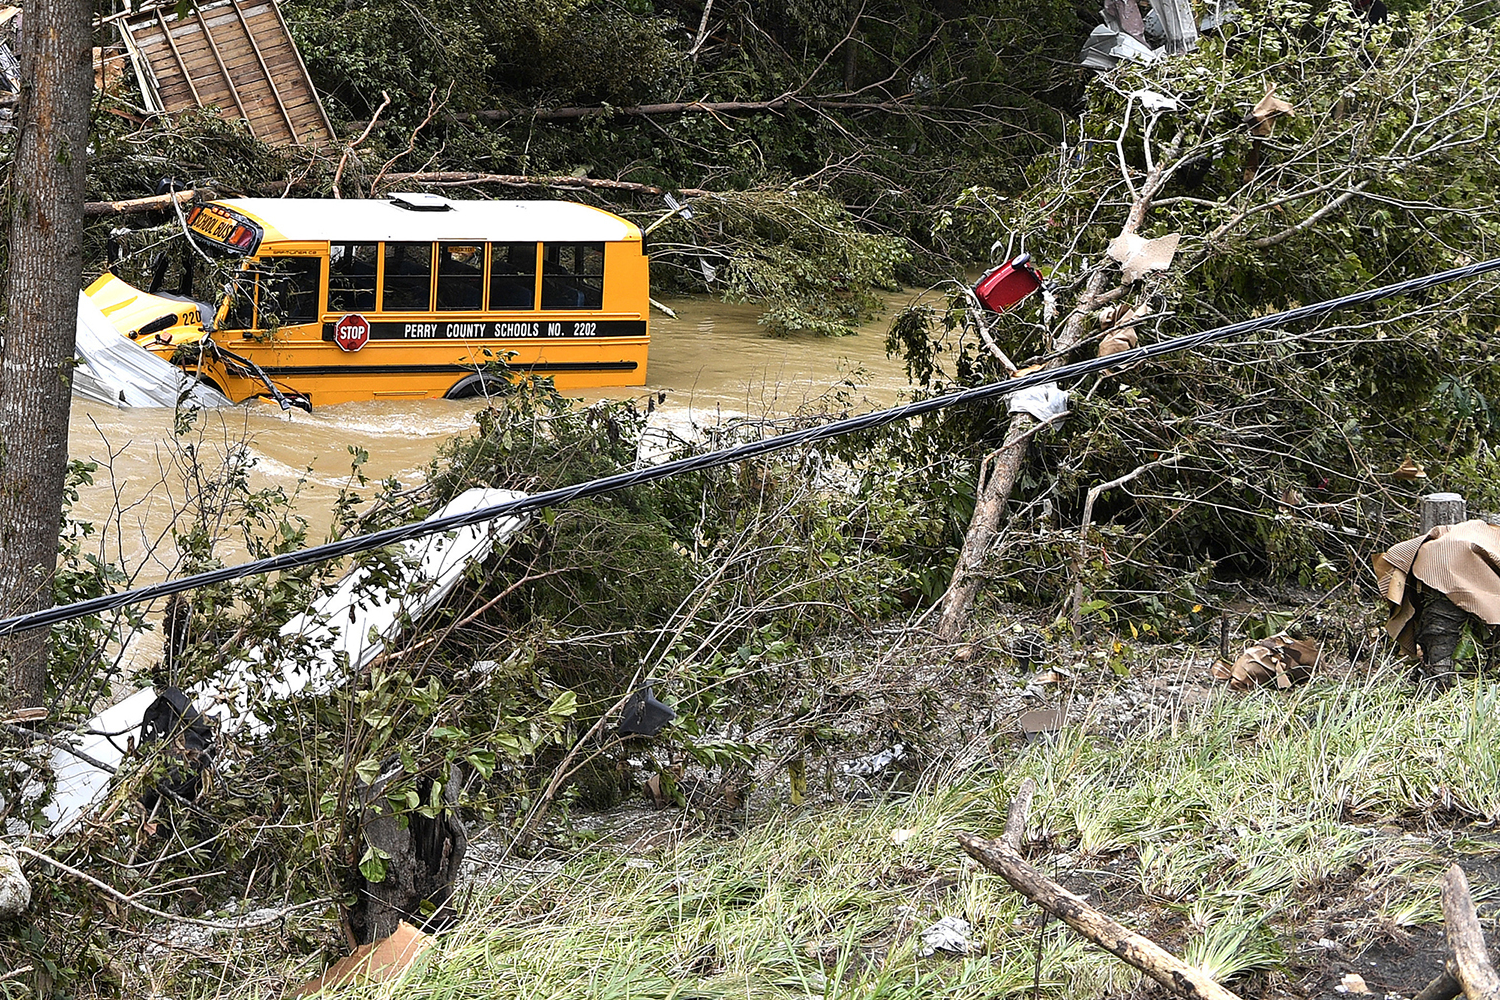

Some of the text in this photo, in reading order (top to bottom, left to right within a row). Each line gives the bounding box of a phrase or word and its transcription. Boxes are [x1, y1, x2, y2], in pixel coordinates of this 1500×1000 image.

[193, 212, 234, 239] SCHOOL BUS
[340, 325, 365, 340] STOP
[404, 322, 597, 338] PERRY COUNTY SCHOOLS NO. 2202
